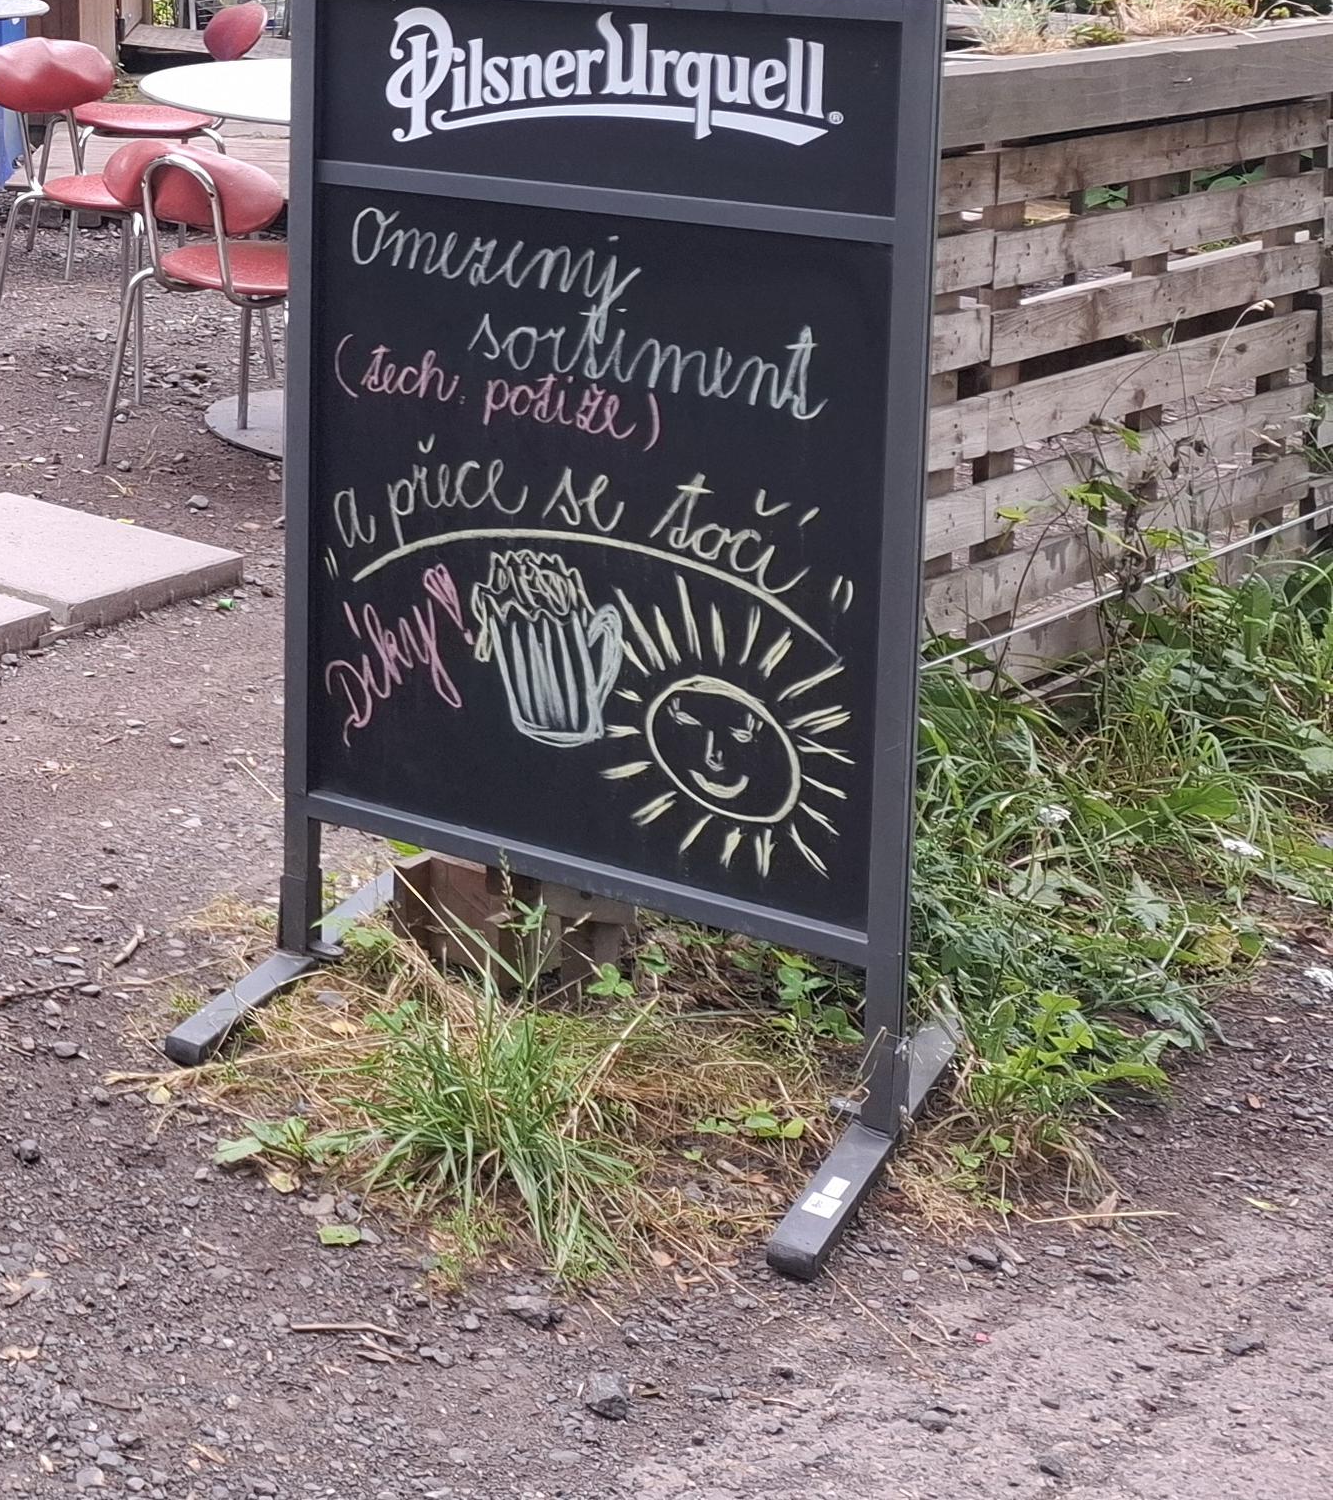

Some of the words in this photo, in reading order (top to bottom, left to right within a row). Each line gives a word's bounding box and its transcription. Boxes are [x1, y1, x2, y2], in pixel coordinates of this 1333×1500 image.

[386, 7, 605, 142] Pilsner
[596, 12, 825, 140] Urquell
[468, 305, 827, 419] sortiment
[387, 434, 528, 547] přece
[541, 466, 625, 532] se
